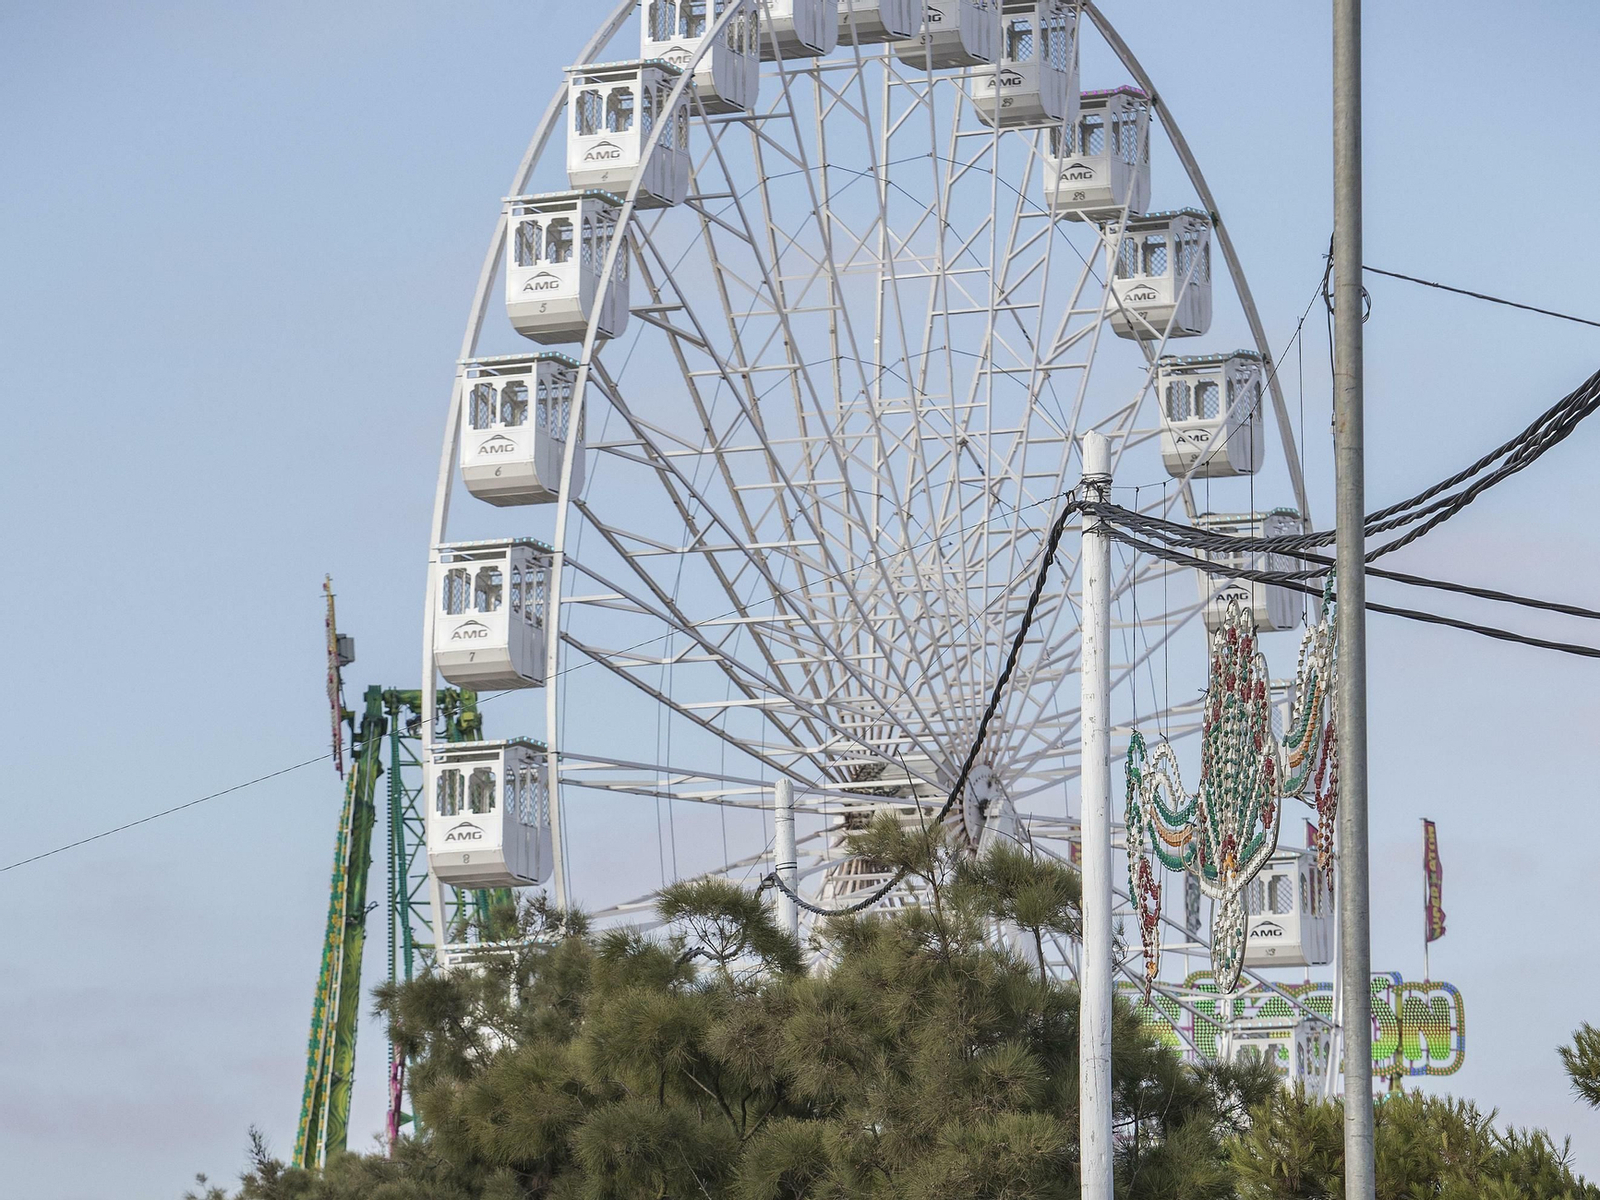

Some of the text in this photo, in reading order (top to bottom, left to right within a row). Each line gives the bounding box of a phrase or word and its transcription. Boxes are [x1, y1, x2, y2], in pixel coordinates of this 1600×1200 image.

[987, 77, 1022, 88] AMG
[583, 149, 621, 161] AMG
[1059, 171, 1093, 182] AMG
[522, 280, 560, 292] AMG
[1122, 292, 1157, 302] AMG
[539, 303, 548, 313] 5
[1176, 433, 1210, 444] AMG
[477, 443, 515, 455] AMG
[494, 466, 502, 477] 6
[1216, 592, 1249, 602] AMG
[450, 629, 488, 640] AMG
[468, 652, 476, 662] 7
[444, 831, 483, 842] AMG
[462, 853, 470, 864] 8
[1249, 929, 1283, 938] AMG
